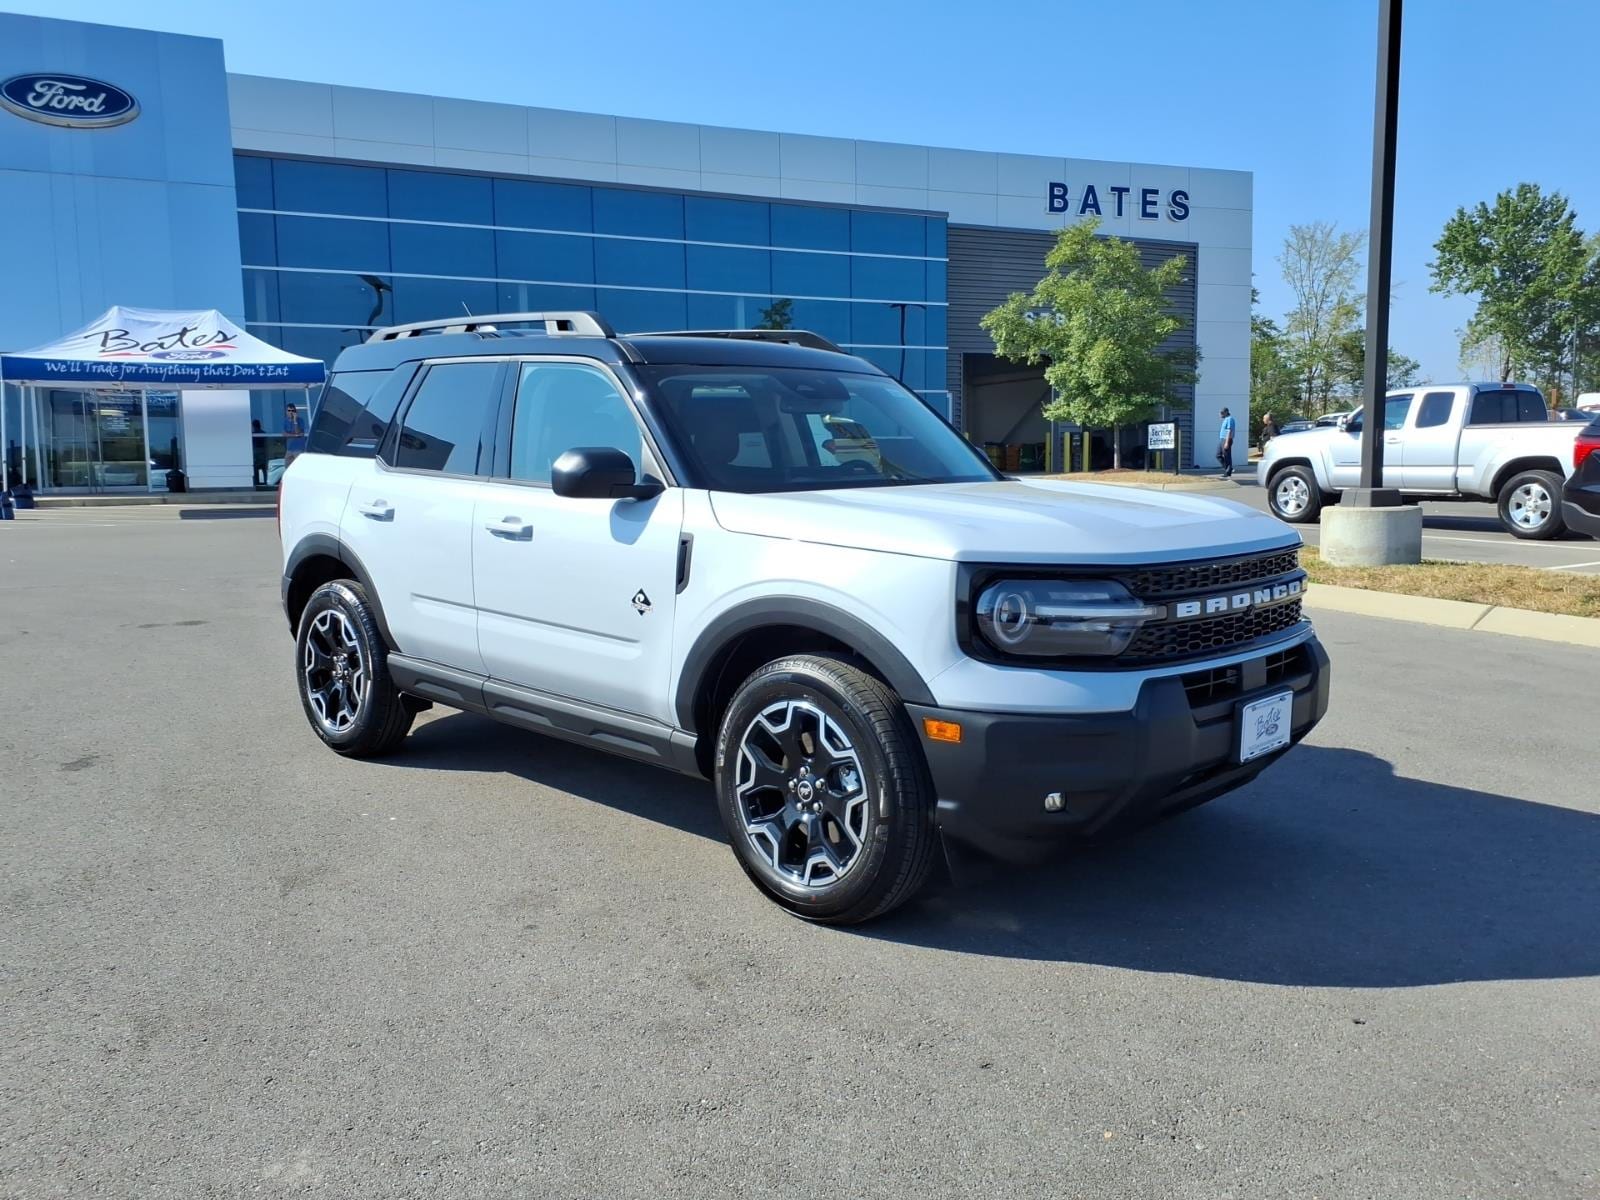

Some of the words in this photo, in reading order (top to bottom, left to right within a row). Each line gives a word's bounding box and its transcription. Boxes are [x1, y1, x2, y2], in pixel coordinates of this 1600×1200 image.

[27, 80, 107, 112] Ford
[1047, 181, 1191, 222] BATES
[83, 326, 238, 353] Bates
[164, 351, 213, 360] Ford
[44, 361, 81, 373] We'll
[83, 361, 119, 377] Trade
[118, 362, 138, 381] for
[138, 363, 201, 383] Anything
[203, 363, 231, 377] that
[231, 364, 265, 377] Don't
[266, 364, 289, 376] Eat
[1176, 581, 1301, 618] BRONCO
